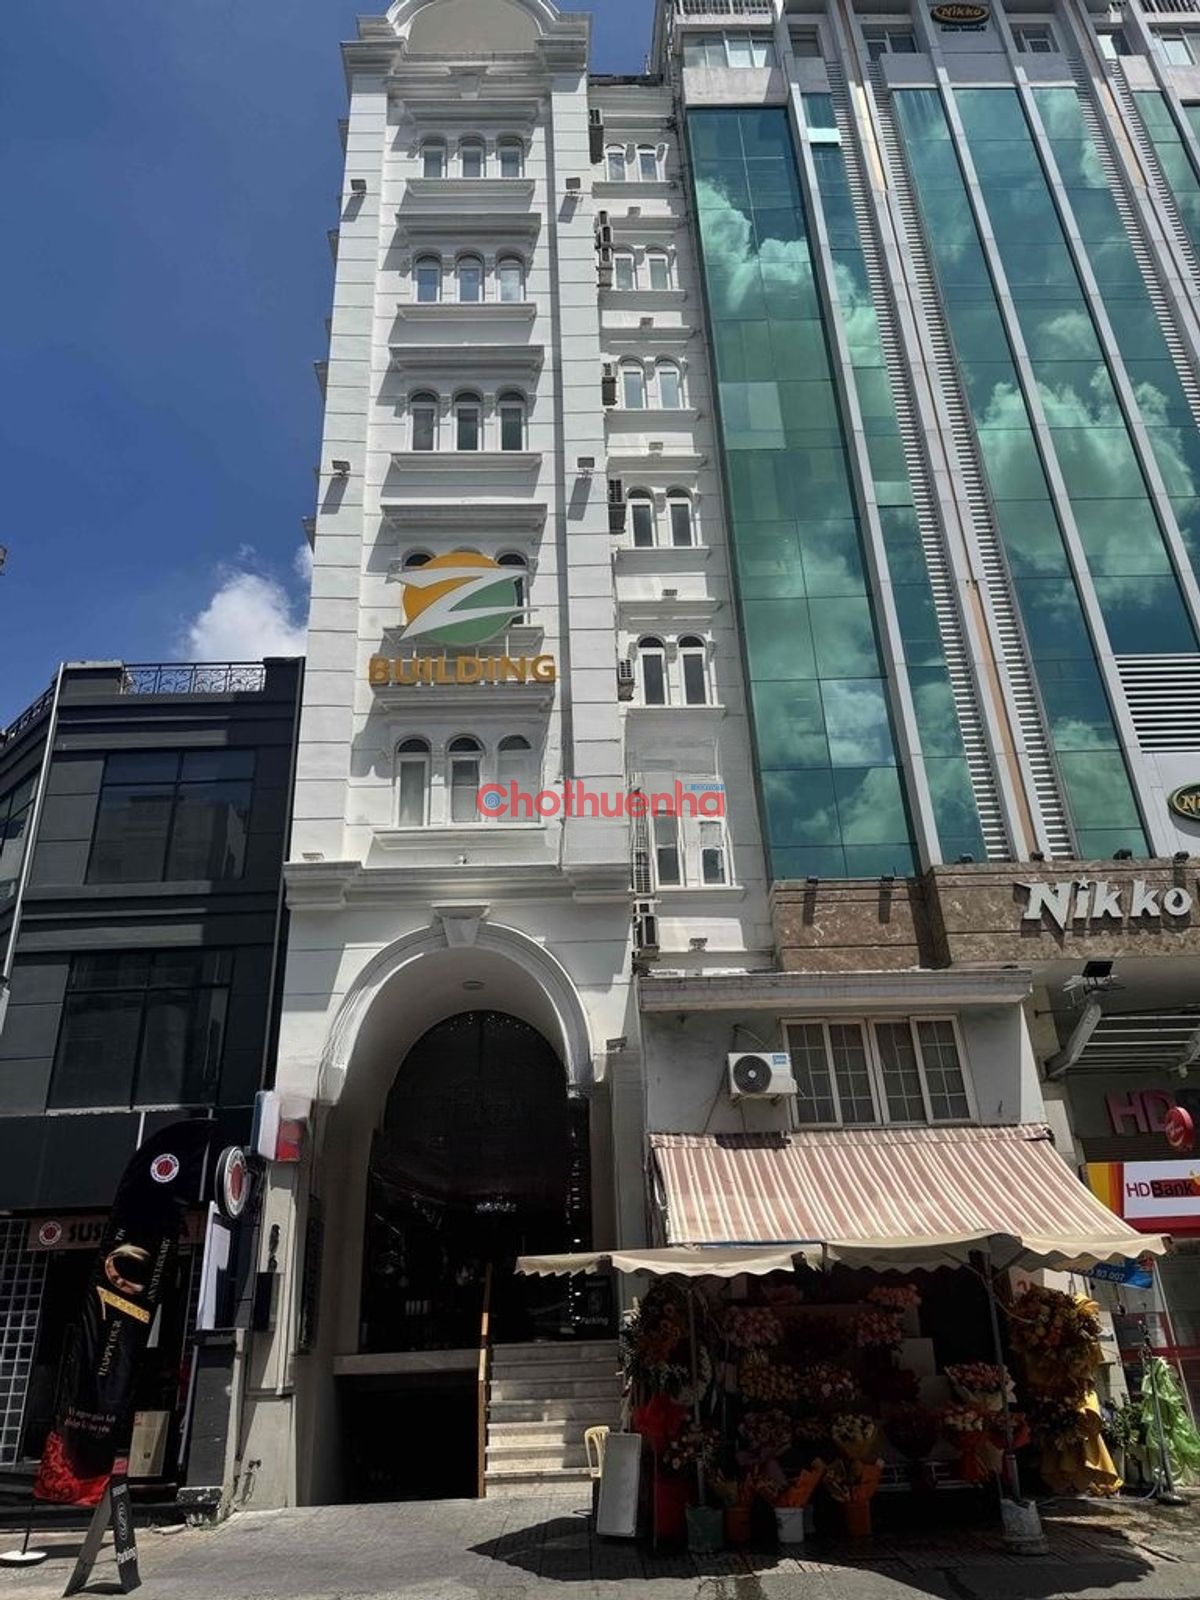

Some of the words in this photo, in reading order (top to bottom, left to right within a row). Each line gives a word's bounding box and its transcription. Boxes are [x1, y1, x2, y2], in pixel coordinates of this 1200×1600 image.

[940, 5, 982, 17] Nikko
[369, 654, 556, 685] BUILDING
[1016, 876, 1193, 929] Nikko
[1126, 1180, 1193, 1198] HDBank
